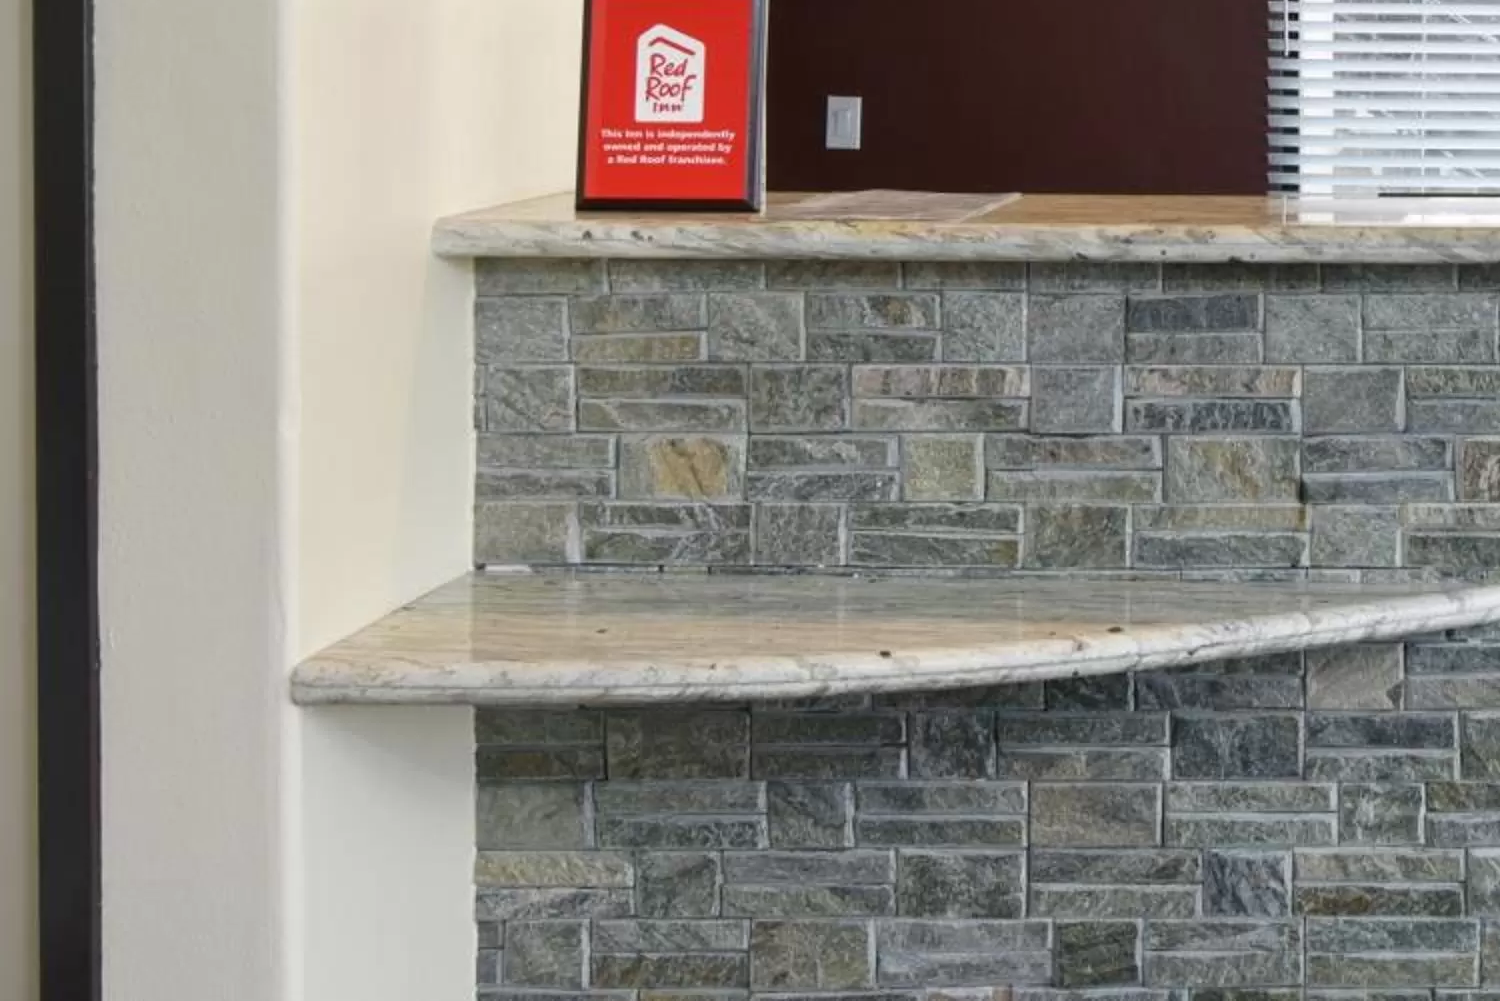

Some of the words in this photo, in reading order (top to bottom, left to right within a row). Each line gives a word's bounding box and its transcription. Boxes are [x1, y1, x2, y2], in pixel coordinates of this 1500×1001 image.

[650, 53, 688, 77] Red
[645, 75, 697, 102] Roof
[601, 128, 623, 139] This
[645, 128, 655, 139] is
[657, 128, 736, 142] independently
[603, 141, 641, 152] owned
[643, 142, 664, 152] and
[666, 142, 716, 153] operated
[717, 142, 733, 154] by
[616, 154, 638, 164] Red
[640, 154, 666, 164] Roof
